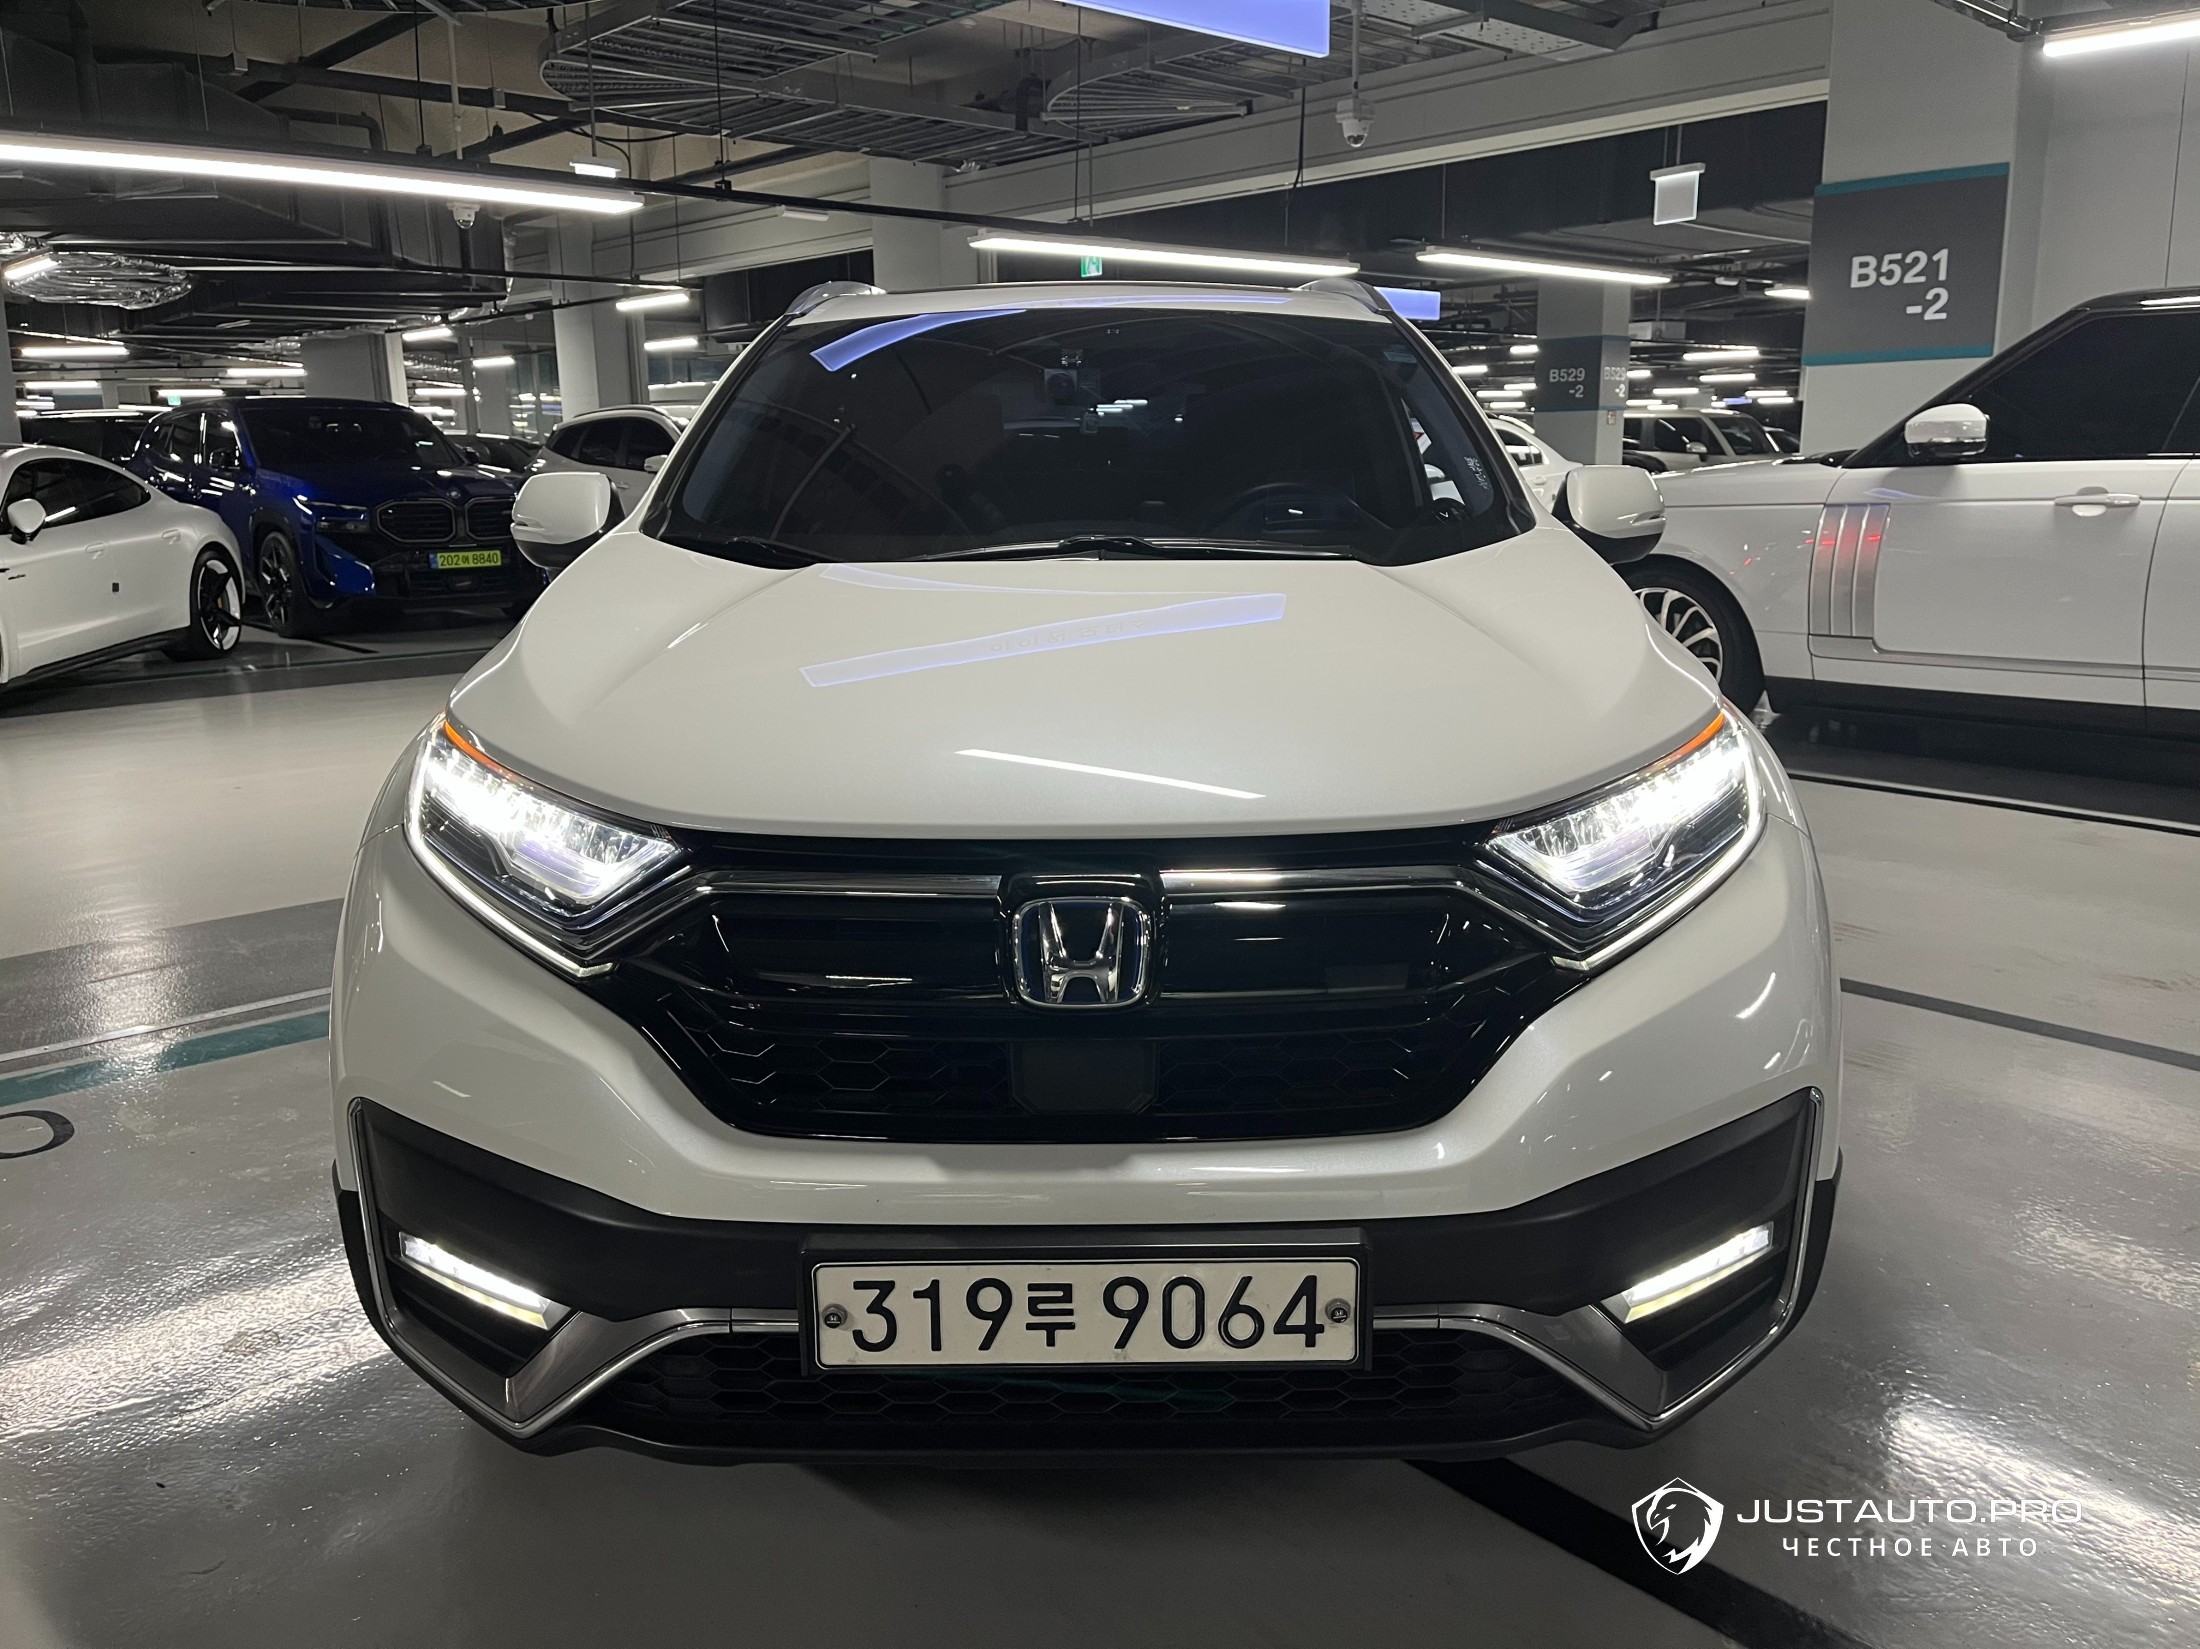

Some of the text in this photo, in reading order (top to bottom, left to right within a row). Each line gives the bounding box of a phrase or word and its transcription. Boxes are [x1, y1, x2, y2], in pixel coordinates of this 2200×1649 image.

[1850, 248, 1949, 288] B521
[1906, 287, 1949, 320] -2
[1549, 367, 1586, 382] B529
[1603, 366, 1627, 380] B529
[1568, 384, 1584, 398] -2
[472, 552, 499, 565] 8840
[852, 1274, 1325, 1352] 319루 9064
